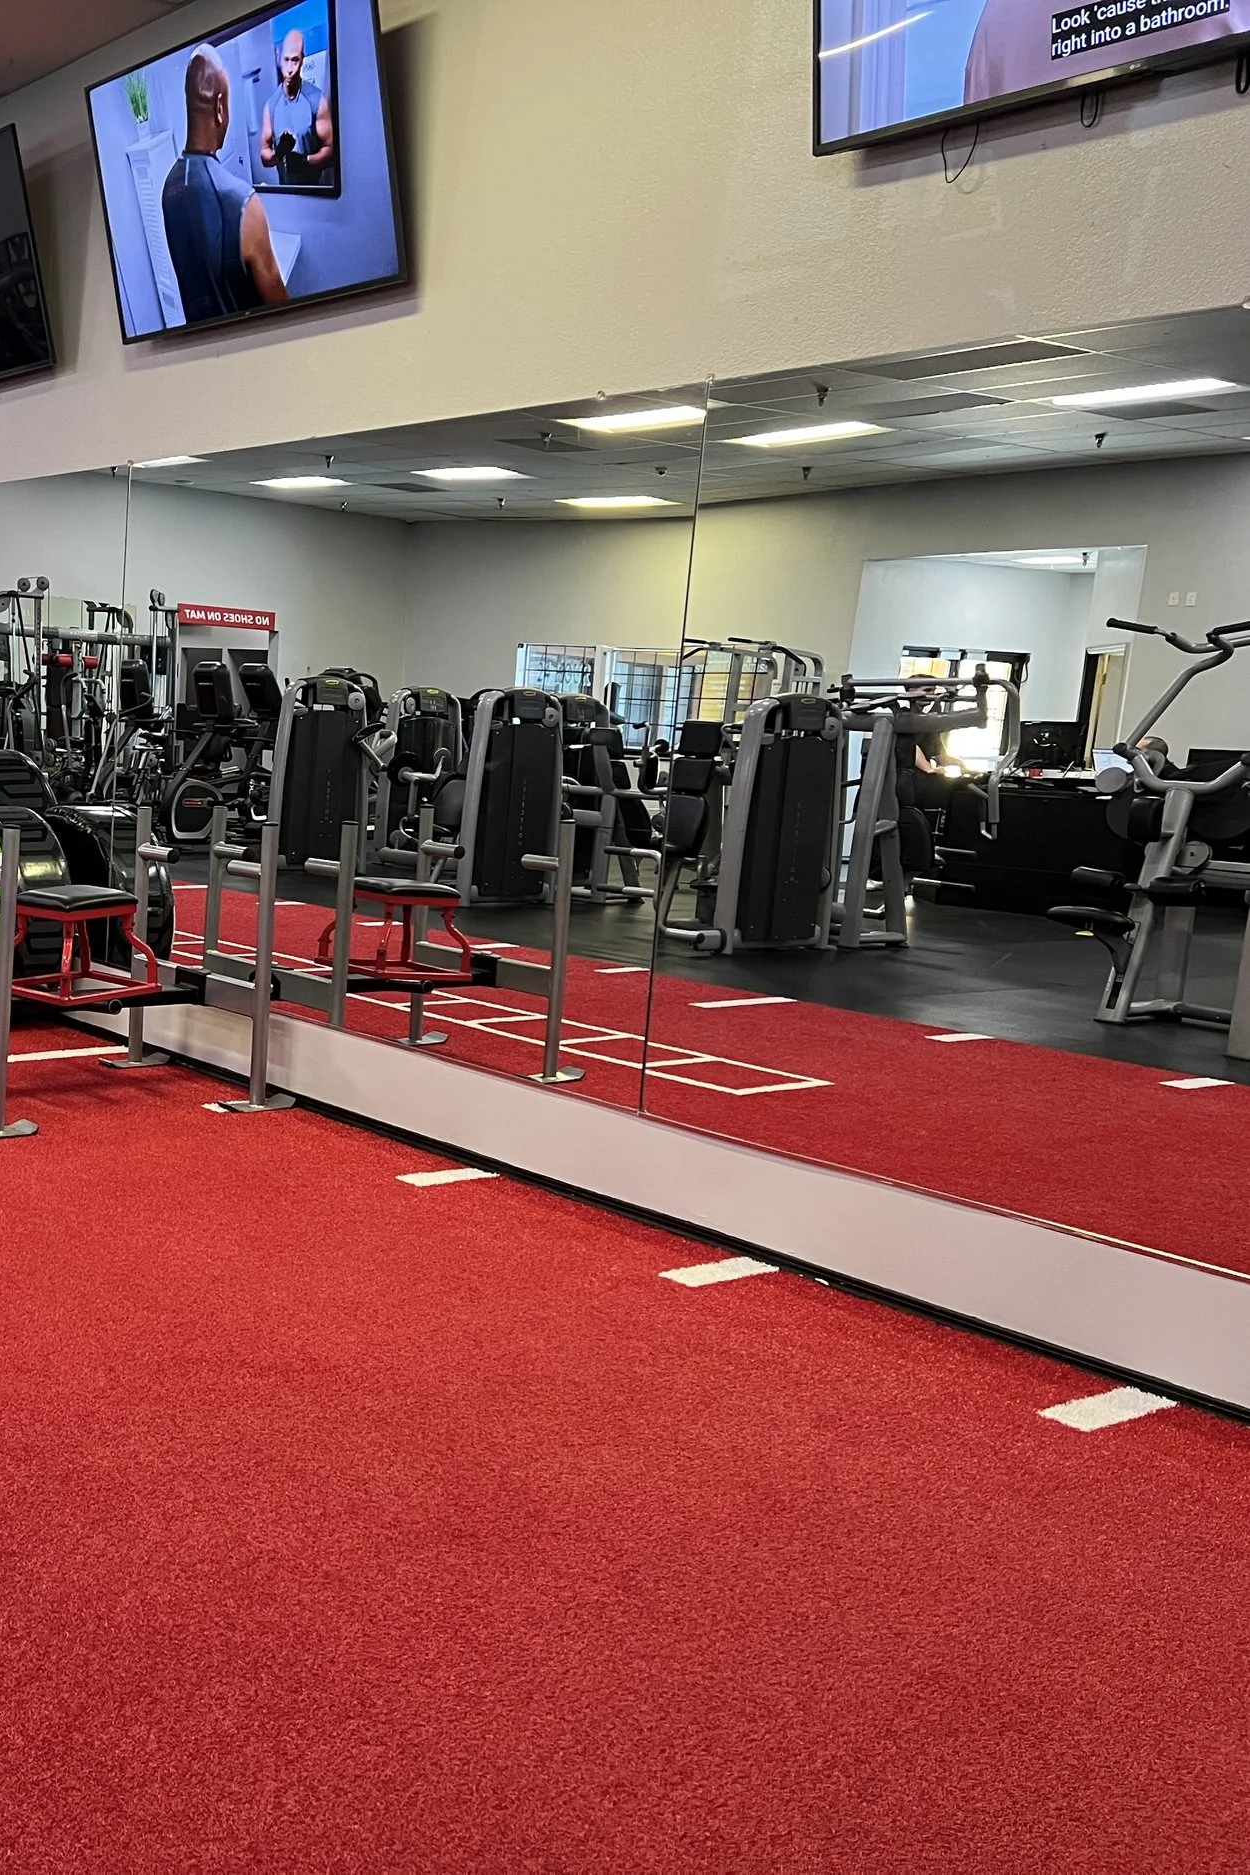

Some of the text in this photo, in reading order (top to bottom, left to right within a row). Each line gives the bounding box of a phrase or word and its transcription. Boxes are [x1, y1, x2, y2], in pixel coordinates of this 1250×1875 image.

[1051, 0, 1230, 57] right into a bathroom.
[1052, 0, 1146, 34] Look 'cause
